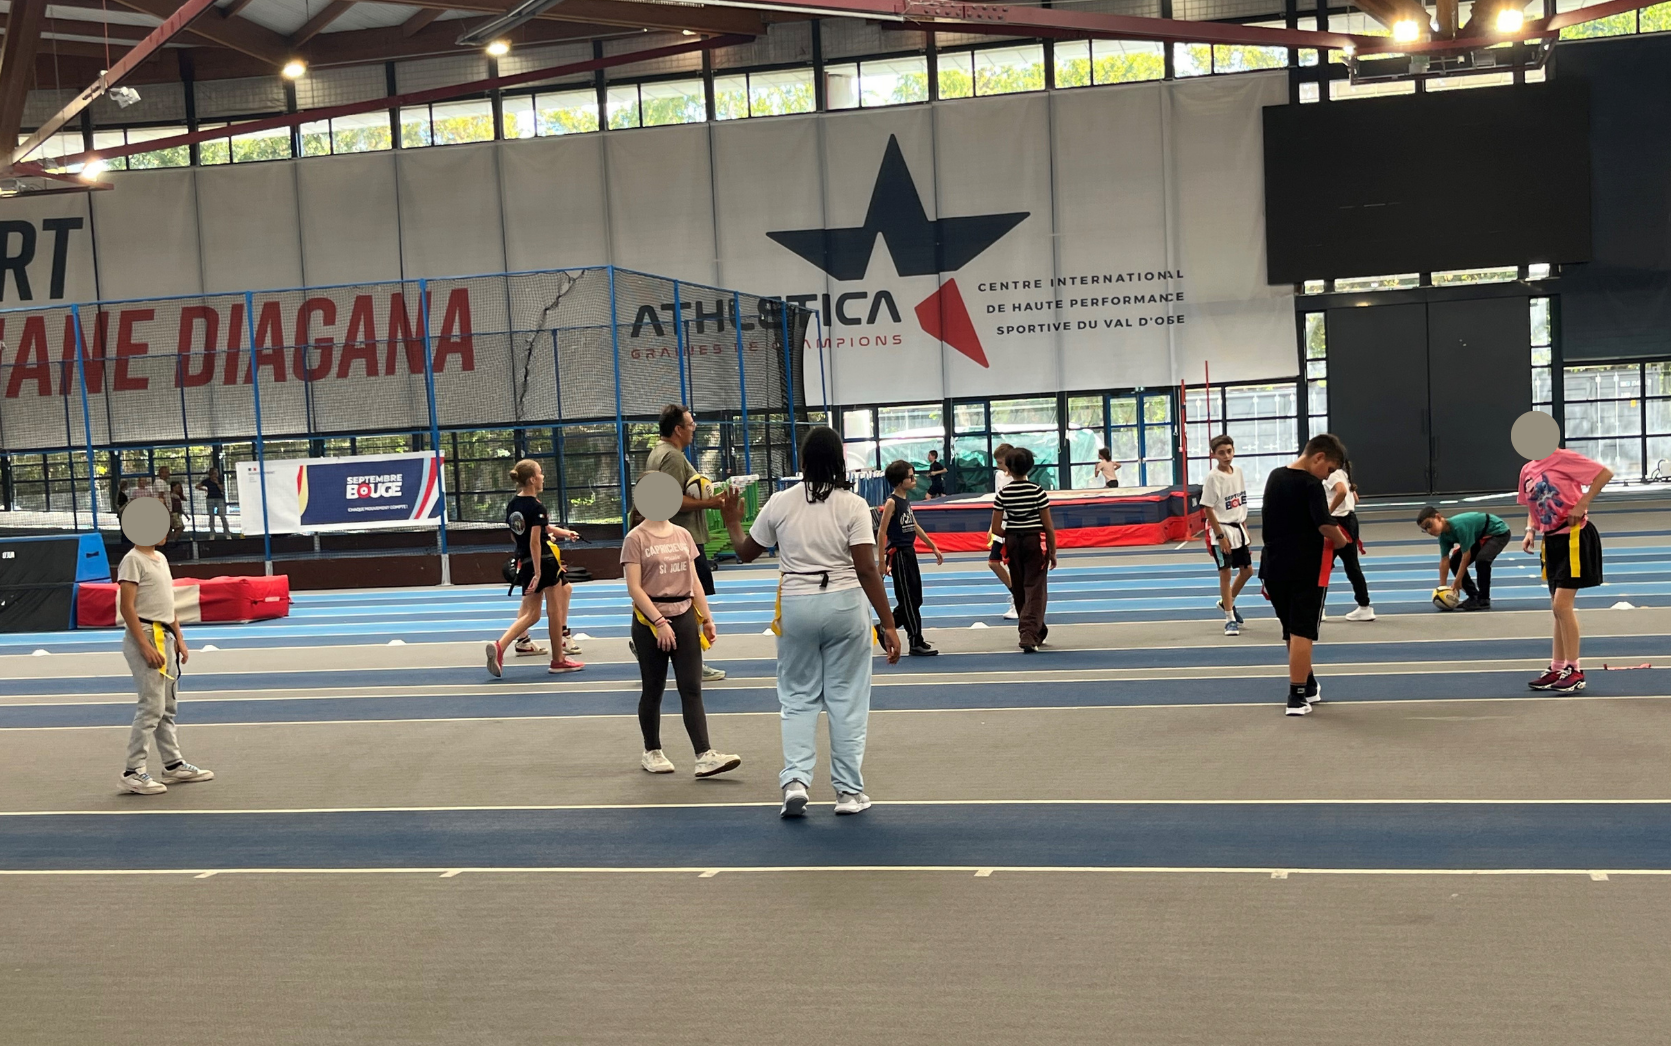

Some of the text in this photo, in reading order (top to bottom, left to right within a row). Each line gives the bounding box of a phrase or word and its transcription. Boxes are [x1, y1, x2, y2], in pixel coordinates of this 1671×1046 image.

[978, 269, 1184, 292] CENTRE INTERNATIONAL
[987, 292, 1184, 314] DE HAUTE PERFORMANCE
[996, 321, 1071, 335] SPORTIVE
[1077, 320, 1098, 330] DU
[1103, 318, 1133, 328] VAL
[0, 288, 476, 398] ANE DIAGANA
[346, 473, 403, 485] SEPTEMBRE
[346, 482, 403, 500] BOUGE
[659, 561, 687, 574] SI JOLIE
